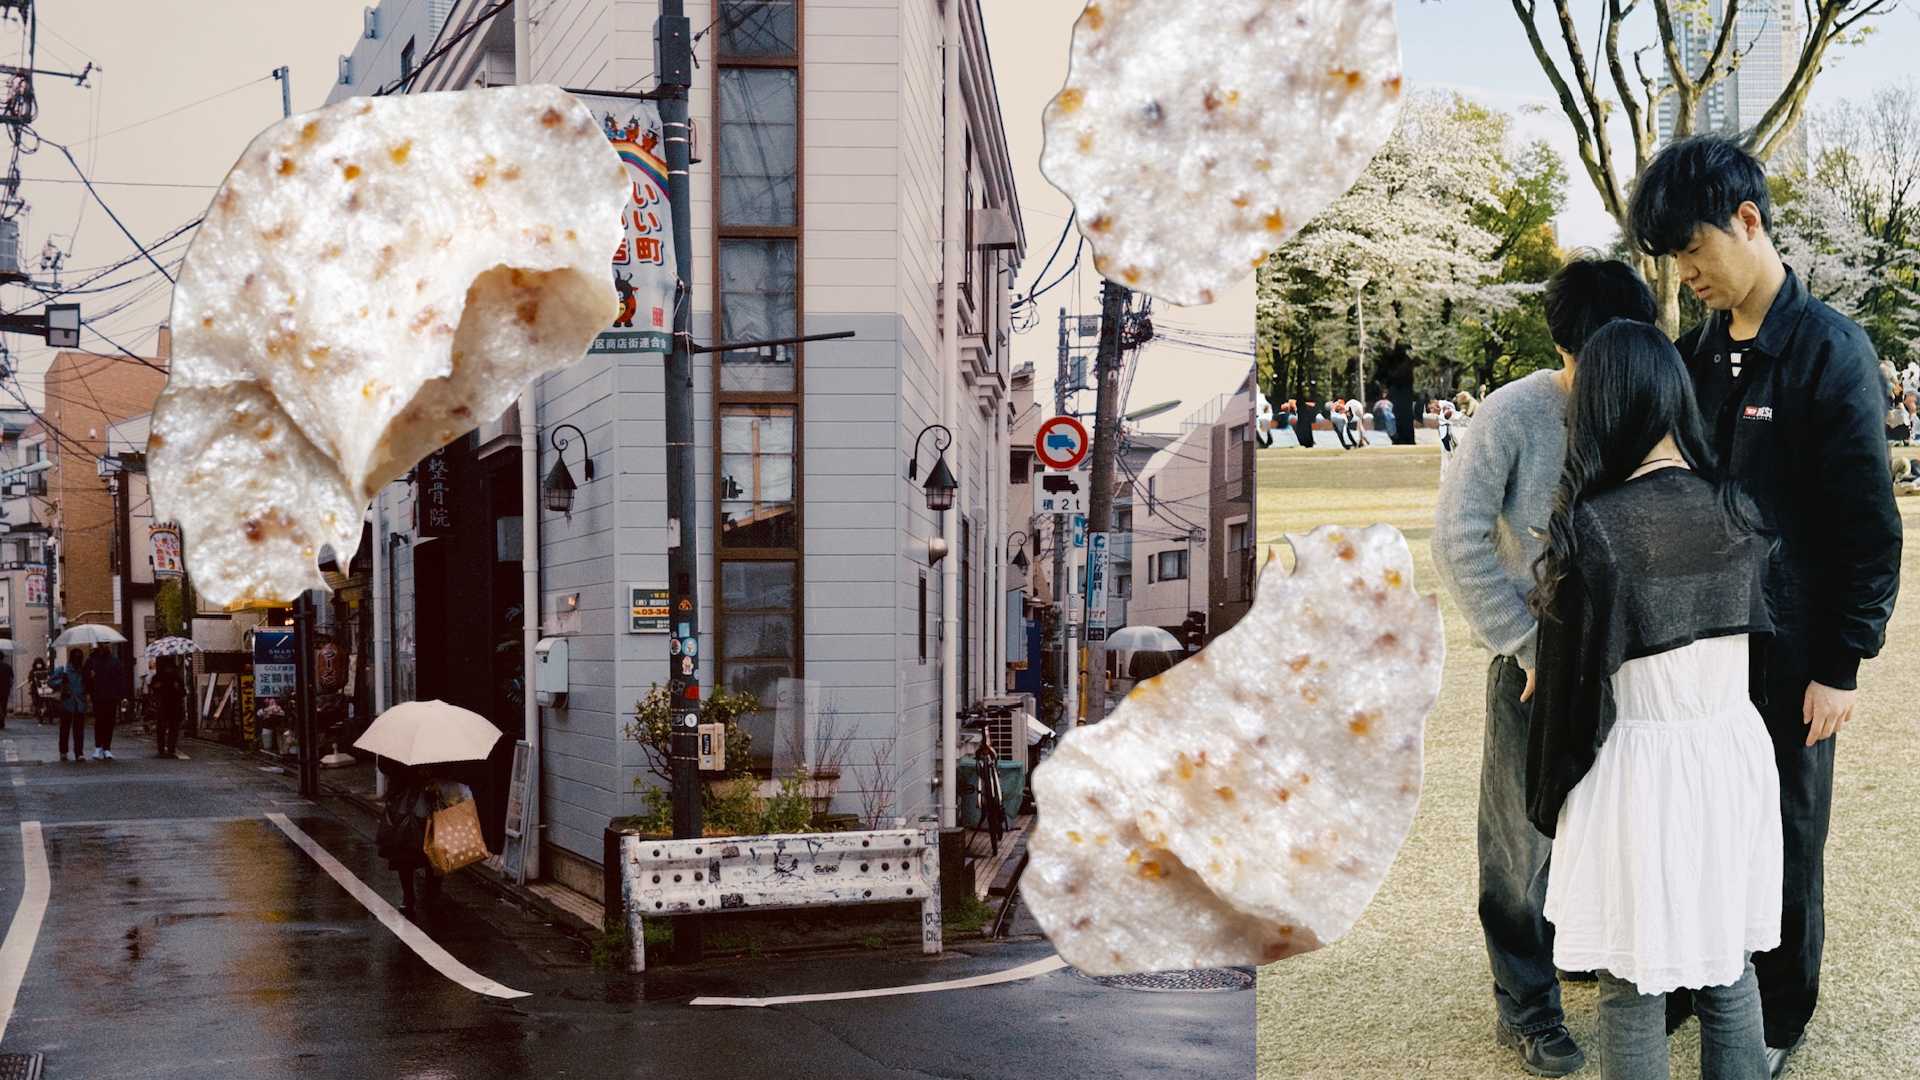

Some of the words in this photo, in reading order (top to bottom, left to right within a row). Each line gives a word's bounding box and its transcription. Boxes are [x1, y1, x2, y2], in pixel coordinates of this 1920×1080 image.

[632, 181, 664, 266] いい町
[591, 336, 667, 349] 区商店街連合会
[1061, 498, 1070, 511] 2
[1075, 498, 1081, 511] t
